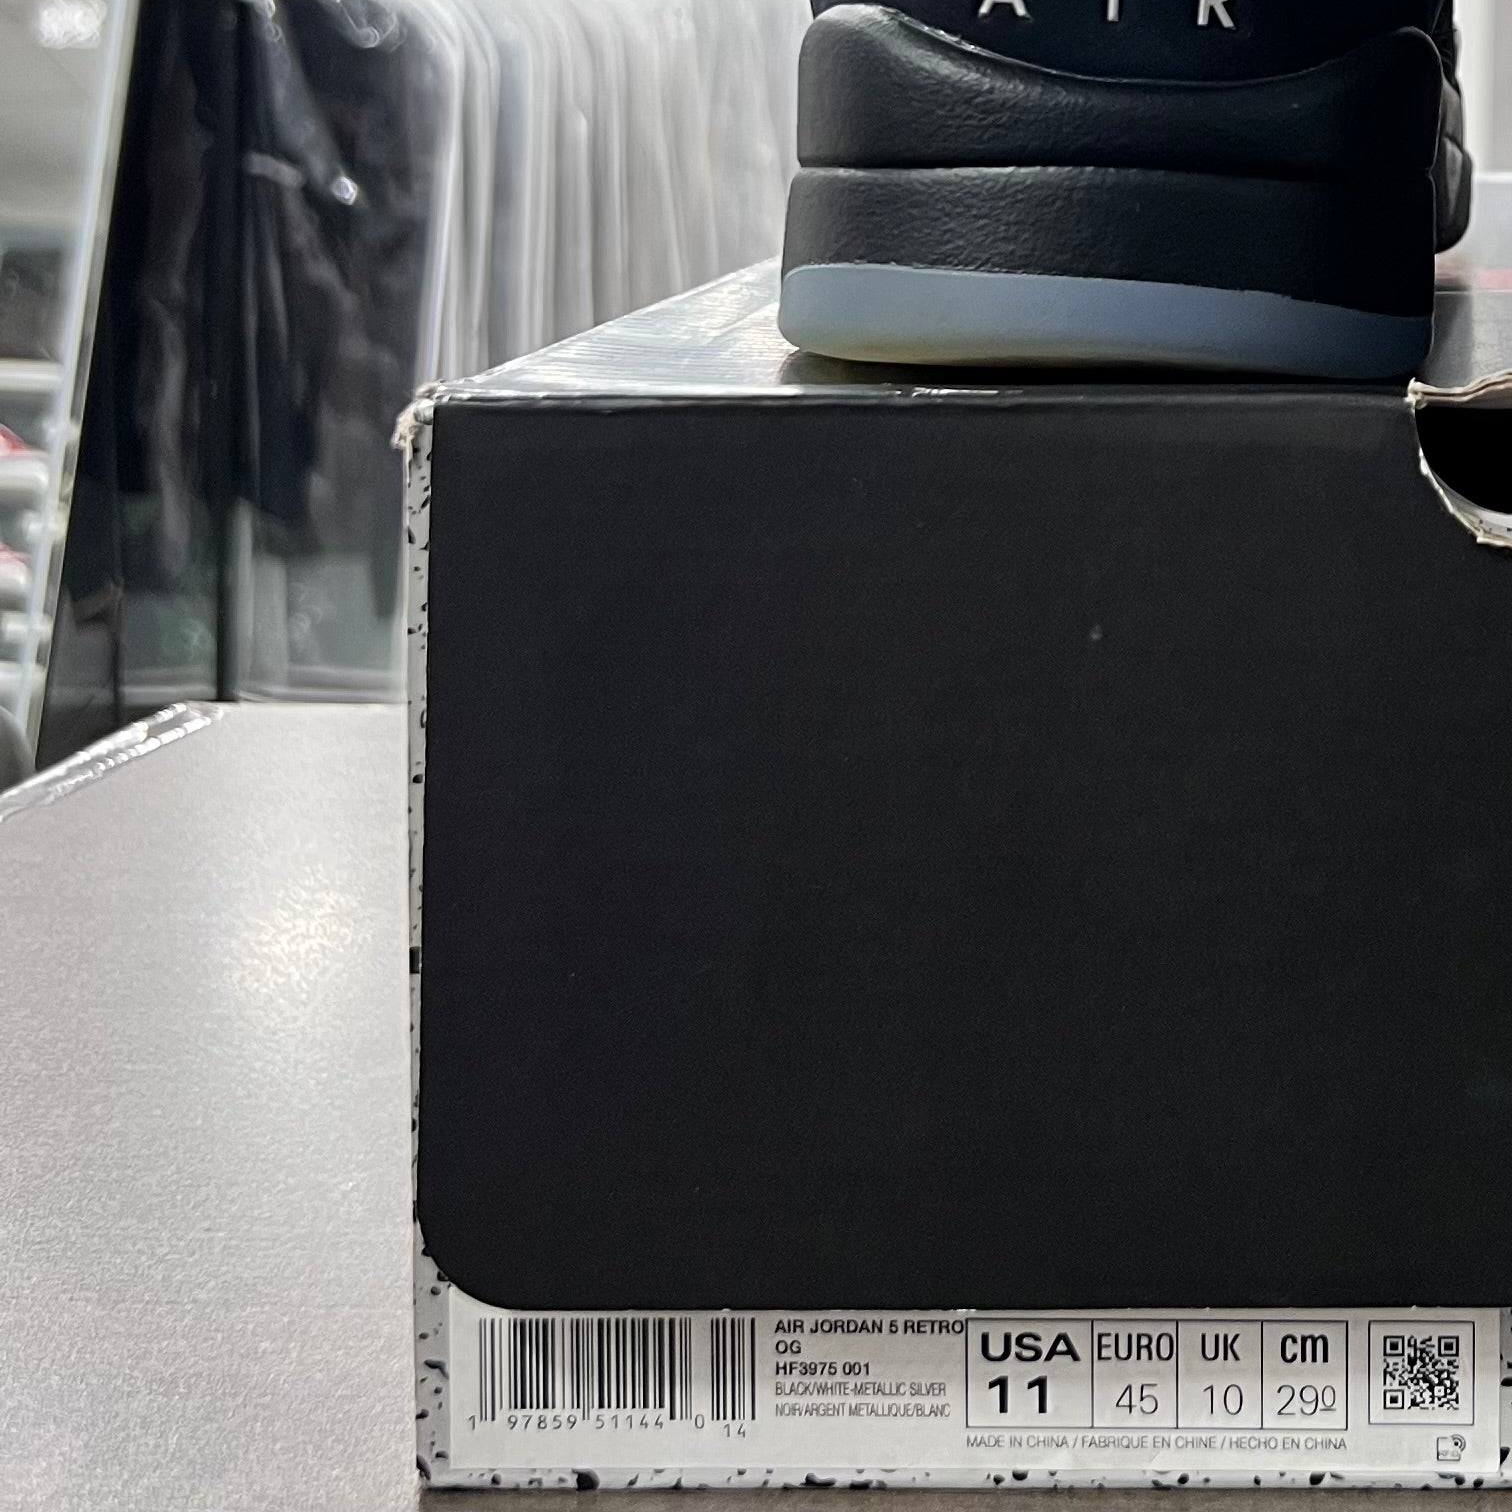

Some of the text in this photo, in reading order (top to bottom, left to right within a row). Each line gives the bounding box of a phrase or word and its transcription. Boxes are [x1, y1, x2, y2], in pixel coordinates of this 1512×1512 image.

[774, 1319, 965, 1335] AIR JORDAN 5 RETRO
[775, 1339, 802, 1355] OG
[979, 1331, 1330, 1364] USA EURO UK cm
[775, 1361, 870, 1376] HF3975 001
[910, 1381, 947, 1397] SILVER
[988, 1374, 1049, 1414] 11
[1114, 1383, 1160, 1416] 45
[1202, 1383, 1244, 1416] 10
[467, 1413, 705, 1431] 1 97859 51144 0
[723, 1422, 747, 1438] 14
[966, 1434, 1006, 1448] MADE
[1009, 1434, 1023, 1448] IN
[1026, 1434, 1069, 1448] CHINA
[1081, 1434, 1149, 1449] FABRIQUE
[1153, 1435, 1171, 1449] EN
[1175, 1435, 1217, 1449] CHINE
[1229, 1435, 1279, 1450] HECHO
[1282, 1436, 1300, 1450] EN
[1304, 1436, 1347, 1450] CHINA
